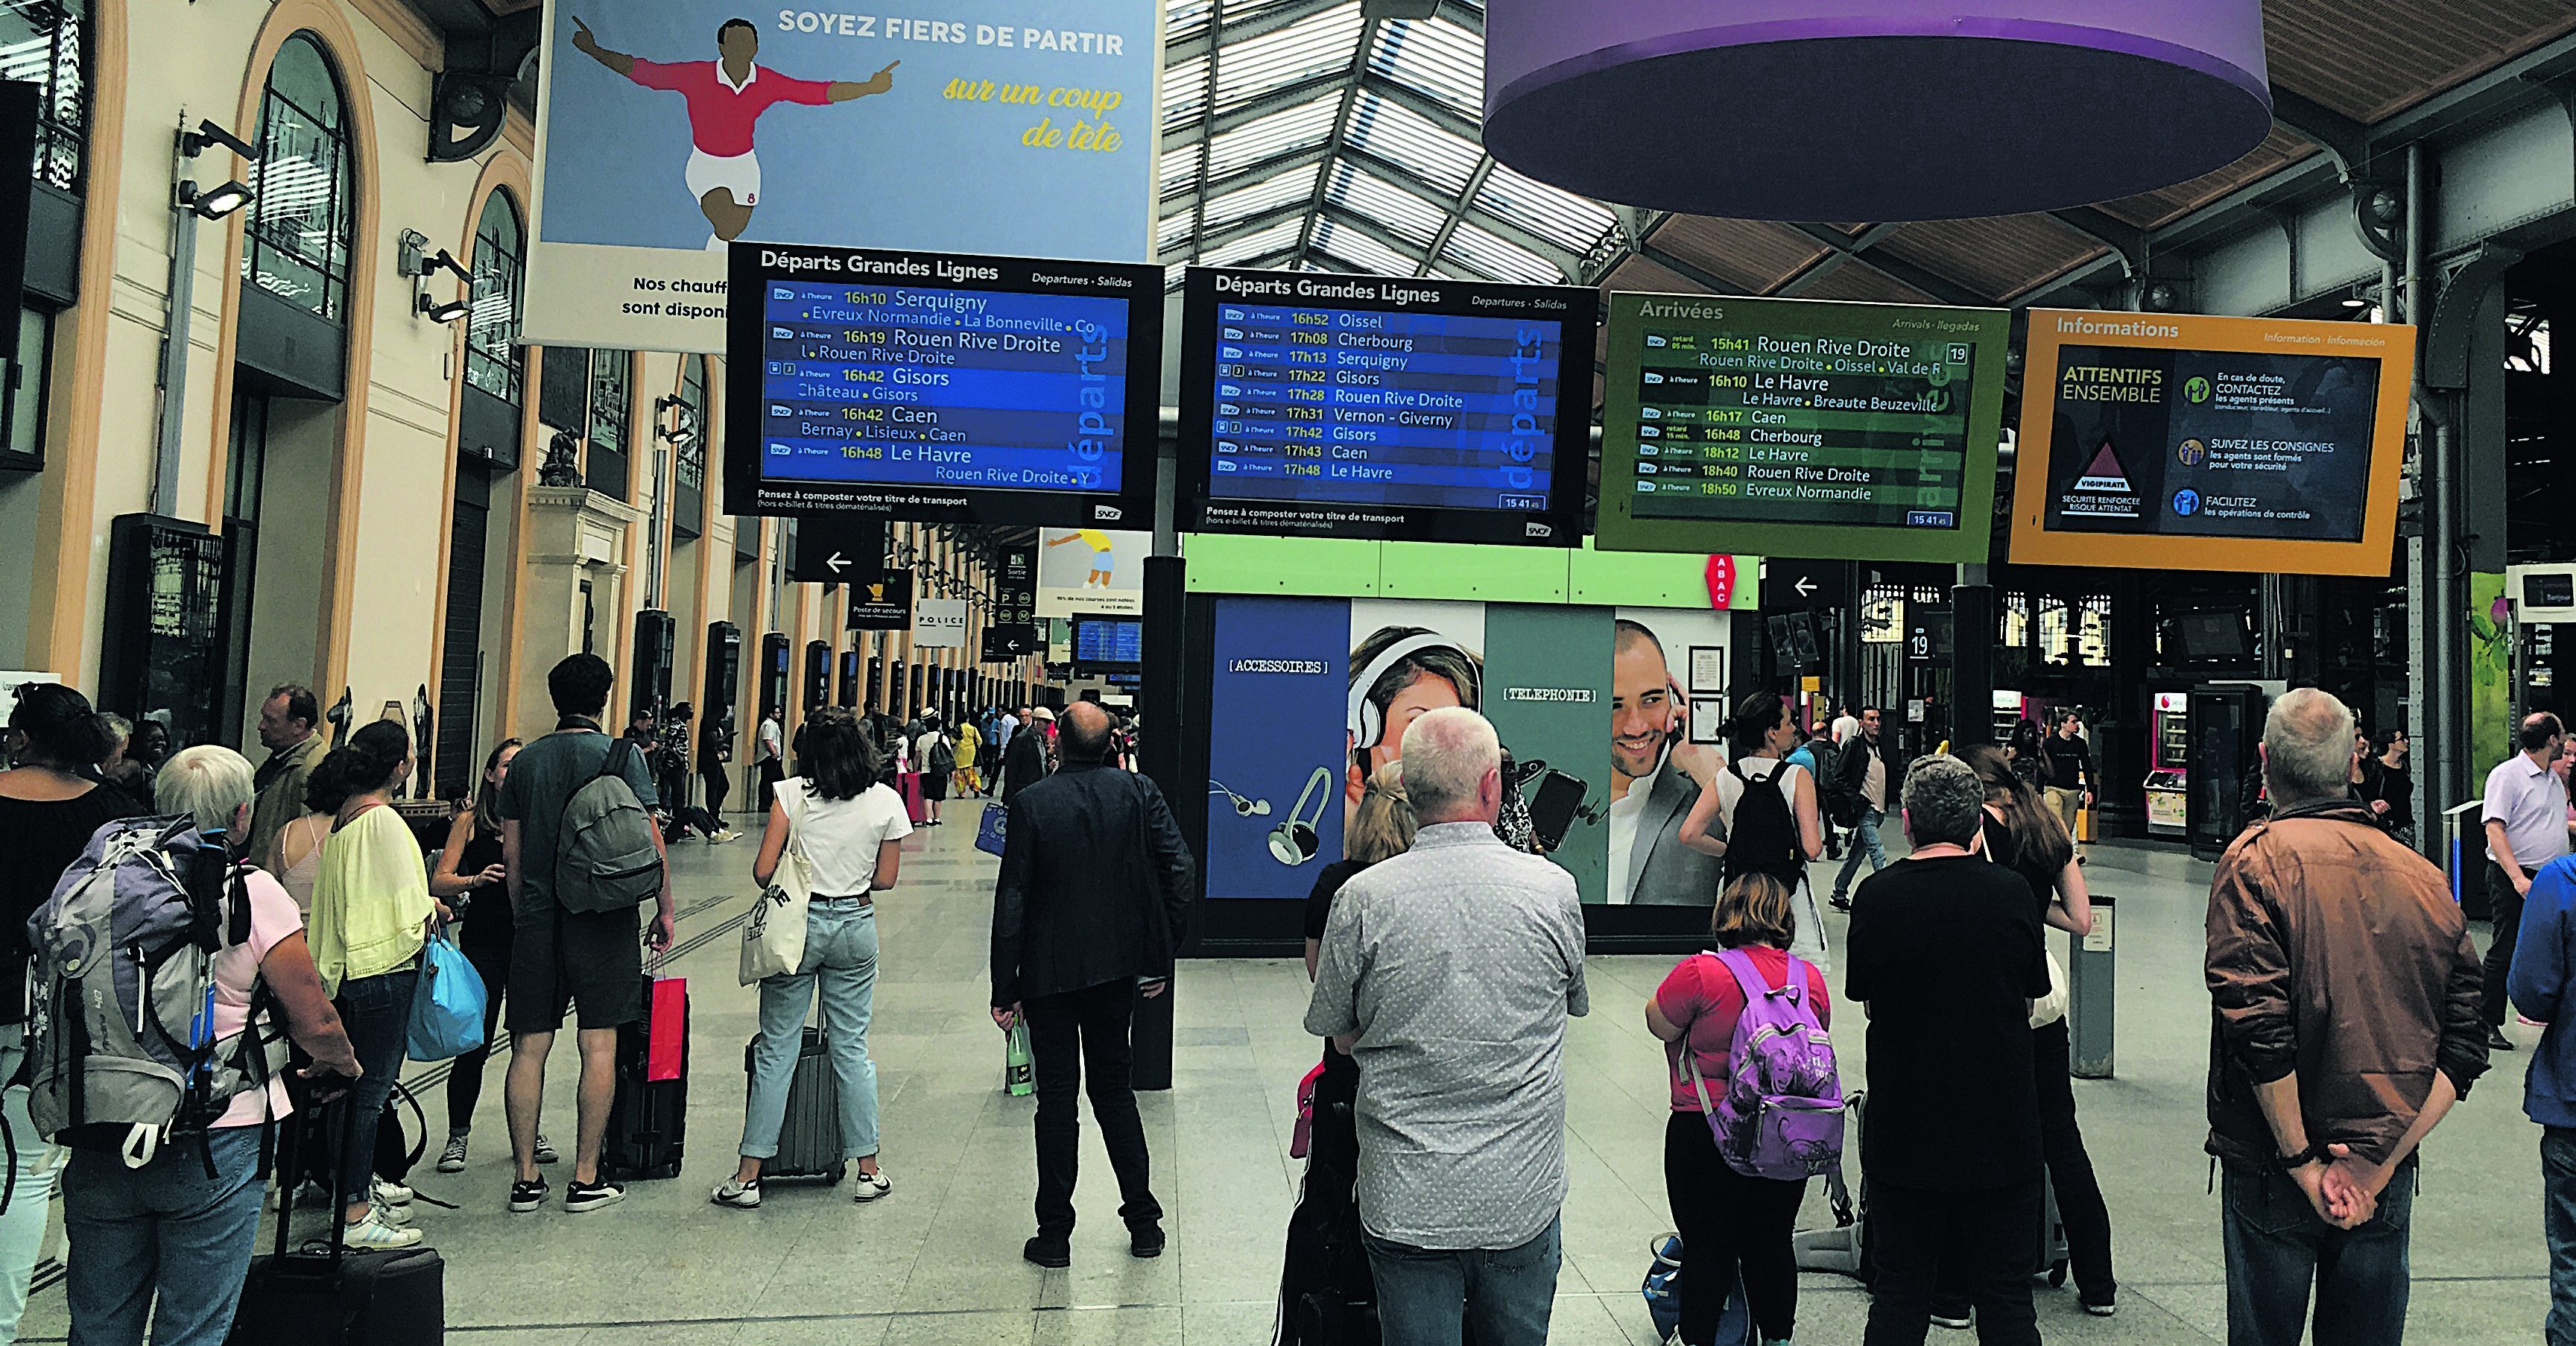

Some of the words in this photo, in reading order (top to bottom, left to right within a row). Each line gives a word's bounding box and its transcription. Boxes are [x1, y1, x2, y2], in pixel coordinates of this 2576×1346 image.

[778, 10, 876, 37] SOYEZ
[886, 18, 966, 43] FIERS
[977, 25, 1013, 47] DE
[1025, 28, 1123, 55] PARTIR
[943, 75, 994, 104] sur
[1000, 79, 1044, 106] un
[1049, 84, 1122, 118] coup
[1022, 118, 1062, 148] de
[1066, 121, 1122, 152] tête
[762, 250, 841, 273] Départs
[848, 256, 930, 276] Grandes
[937, 261, 998, 282] Lignes
[634, 278, 665, 291] Nos
[1032, 274, 1088, 285] Departures
[1098, 277, 1132, 287] Salidas
[1216, 275, 1291, 297] Départs
[1297, 279, 1375, 299] Grandes
[1382, 285, 1440, 305] Lignes
[622, 303, 660, 315] sont
[845, 291, 886, 304] 16h10
[896, 291, 987, 315] Serquigny
[1639, 301, 1723, 319] Arrivées
[814, 306, 863, 320] Evreux
[869, 309, 952, 325] Normandie
[965, 314, 980, 326] La
[987, 315, 1062, 331] Bonneville
[1292, 313, 1328, 325] 16h52
[1340, 314, 1382, 328] Oissel
[1893, 319, 1930, 329] Arrivals
[2057, 317, 2178, 337] Informations
[844, 331, 884, 344] 16h19
[895, 329, 952, 347] Rouen
[960, 332, 997, 349] Rive
[1004, 335, 1060, 352] Droite
[1291, 332, 1327, 344] 17h08
[1339, 332, 1412, 352] Cherbourg
[2265, 333, 2320, 343] Information
[2327, 335, 2384, 346] Información
[820, 346, 866, 360] Rouen
[873, 348, 903, 361] Rive
[908, 350, 955, 364] Droite
[1712, 338, 1748, 350] 15h41
[1758, 337, 1810, 353] Rouen
[1817, 339, 1852, 355] Rive
[1858, 341, 1910, 357] Droite
[1951, 348, 1965, 360] 19
[1290, 351, 1326, 363] 17h13
[1338, 352, 1408, 370] Serquigny
[1700, 353, 1742, 367] Rouen
[1748, 355, 1776, 368] Rive
[1781, 356, 1823, 370] Droite
[1835, 359, 1876, 373] Oissel
[1887, 361, 1908, 373] Val
[1912, 362, 1928, 374] de
[843, 370, 884, 382] 16h42
[893, 368, 949, 385] Gisors
[1289, 370, 1325, 382] 17h22
[1337, 370, 1379, 385] Gisors
[1709, 375, 1747, 388] 16h10
[1756, 373, 1773, 388] Le
[1780, 374, 1828, 391] Havre
[2063, 367, 2162, 384] ATTENTIFS
[2259, 374, 2285, 384] doute,
[873, 387, 917, 401] Gisors
[1288, 388, 1324, 400] 17h28
[1336, 389, 1379, 404] Rouen
[1385, 392, 1414, 405] Rive
[1419, 394, 1462, 408] Droite
[2063, 385, 2160, 402] ENSEMBLE
[2216, 383, 2281, 396] CONTACTEZ
[1743, 392, 1759, 404] Le
[1763, 393, 1802, 406] Havre
[1814, 395, 1867, 408] Breaute
[2216, 394, 2227, 402] les
[2259, 396, 2294, 405] présents
[842, 408, 883, 420] 16h42
[893, 407, 937, 423] Caen
[1500, 329, 1545, 489] départs
[1706, 411, 1742, 422] 16h17
[1753, 411, 1785, 423] Caen
[1287, 408, 1323, 420] 17h31
[1335, 408, 1384, 423] Vernon
[1399, 411, 1452, 429] Giverny
[803, 423, 852, 440] Bernay
[867, 426, 916, 439] Lisieux
[930, 428, 965, 441] Caen
[1705, 429, 1740, 440] 16h48
[1751, 429, 1822, 446] Cherbourg
[841, 446, 882, 458] 16h48
[892, 445, 911, 460] Le
[919, 446, 971, 463] Havre
[1703, 447, 1738, 458] 18h12
[1750, 447, 1765, 459] Le
[1769, 448, 1808, 461] Havre
[2212, 439, 2247, 449] SUIVEZ
[2251, 440, 2269, 450] LES
[2272, 441, 2334, 452] CONSIGNES
[2210, 450, 2221, 458] les
[2224, 453, 2251, 461] agents
[2274, 452, 2301, 461] formés
[937, 467, 981, 480] Rouen
[987, 468, 1017, 481] Rive
[1023, 470, 1068, 484] Droite
[1284, 464, 1320, 475] 17h48
[1332, 464, 1347, 477] Le
[1352, 465, 1392, 478] Havre
[1701, 484, 1736, 495] 18h50
[1747, 484, 1791, 497] Evreux
[1796, 485, 1871, 500] Normandie
[2081, 480, 2124, 488] VIGIPIRATE
[2206, 496, 2256, 507] FACILITEZ
[1911, 636, 1928, 655] 19
